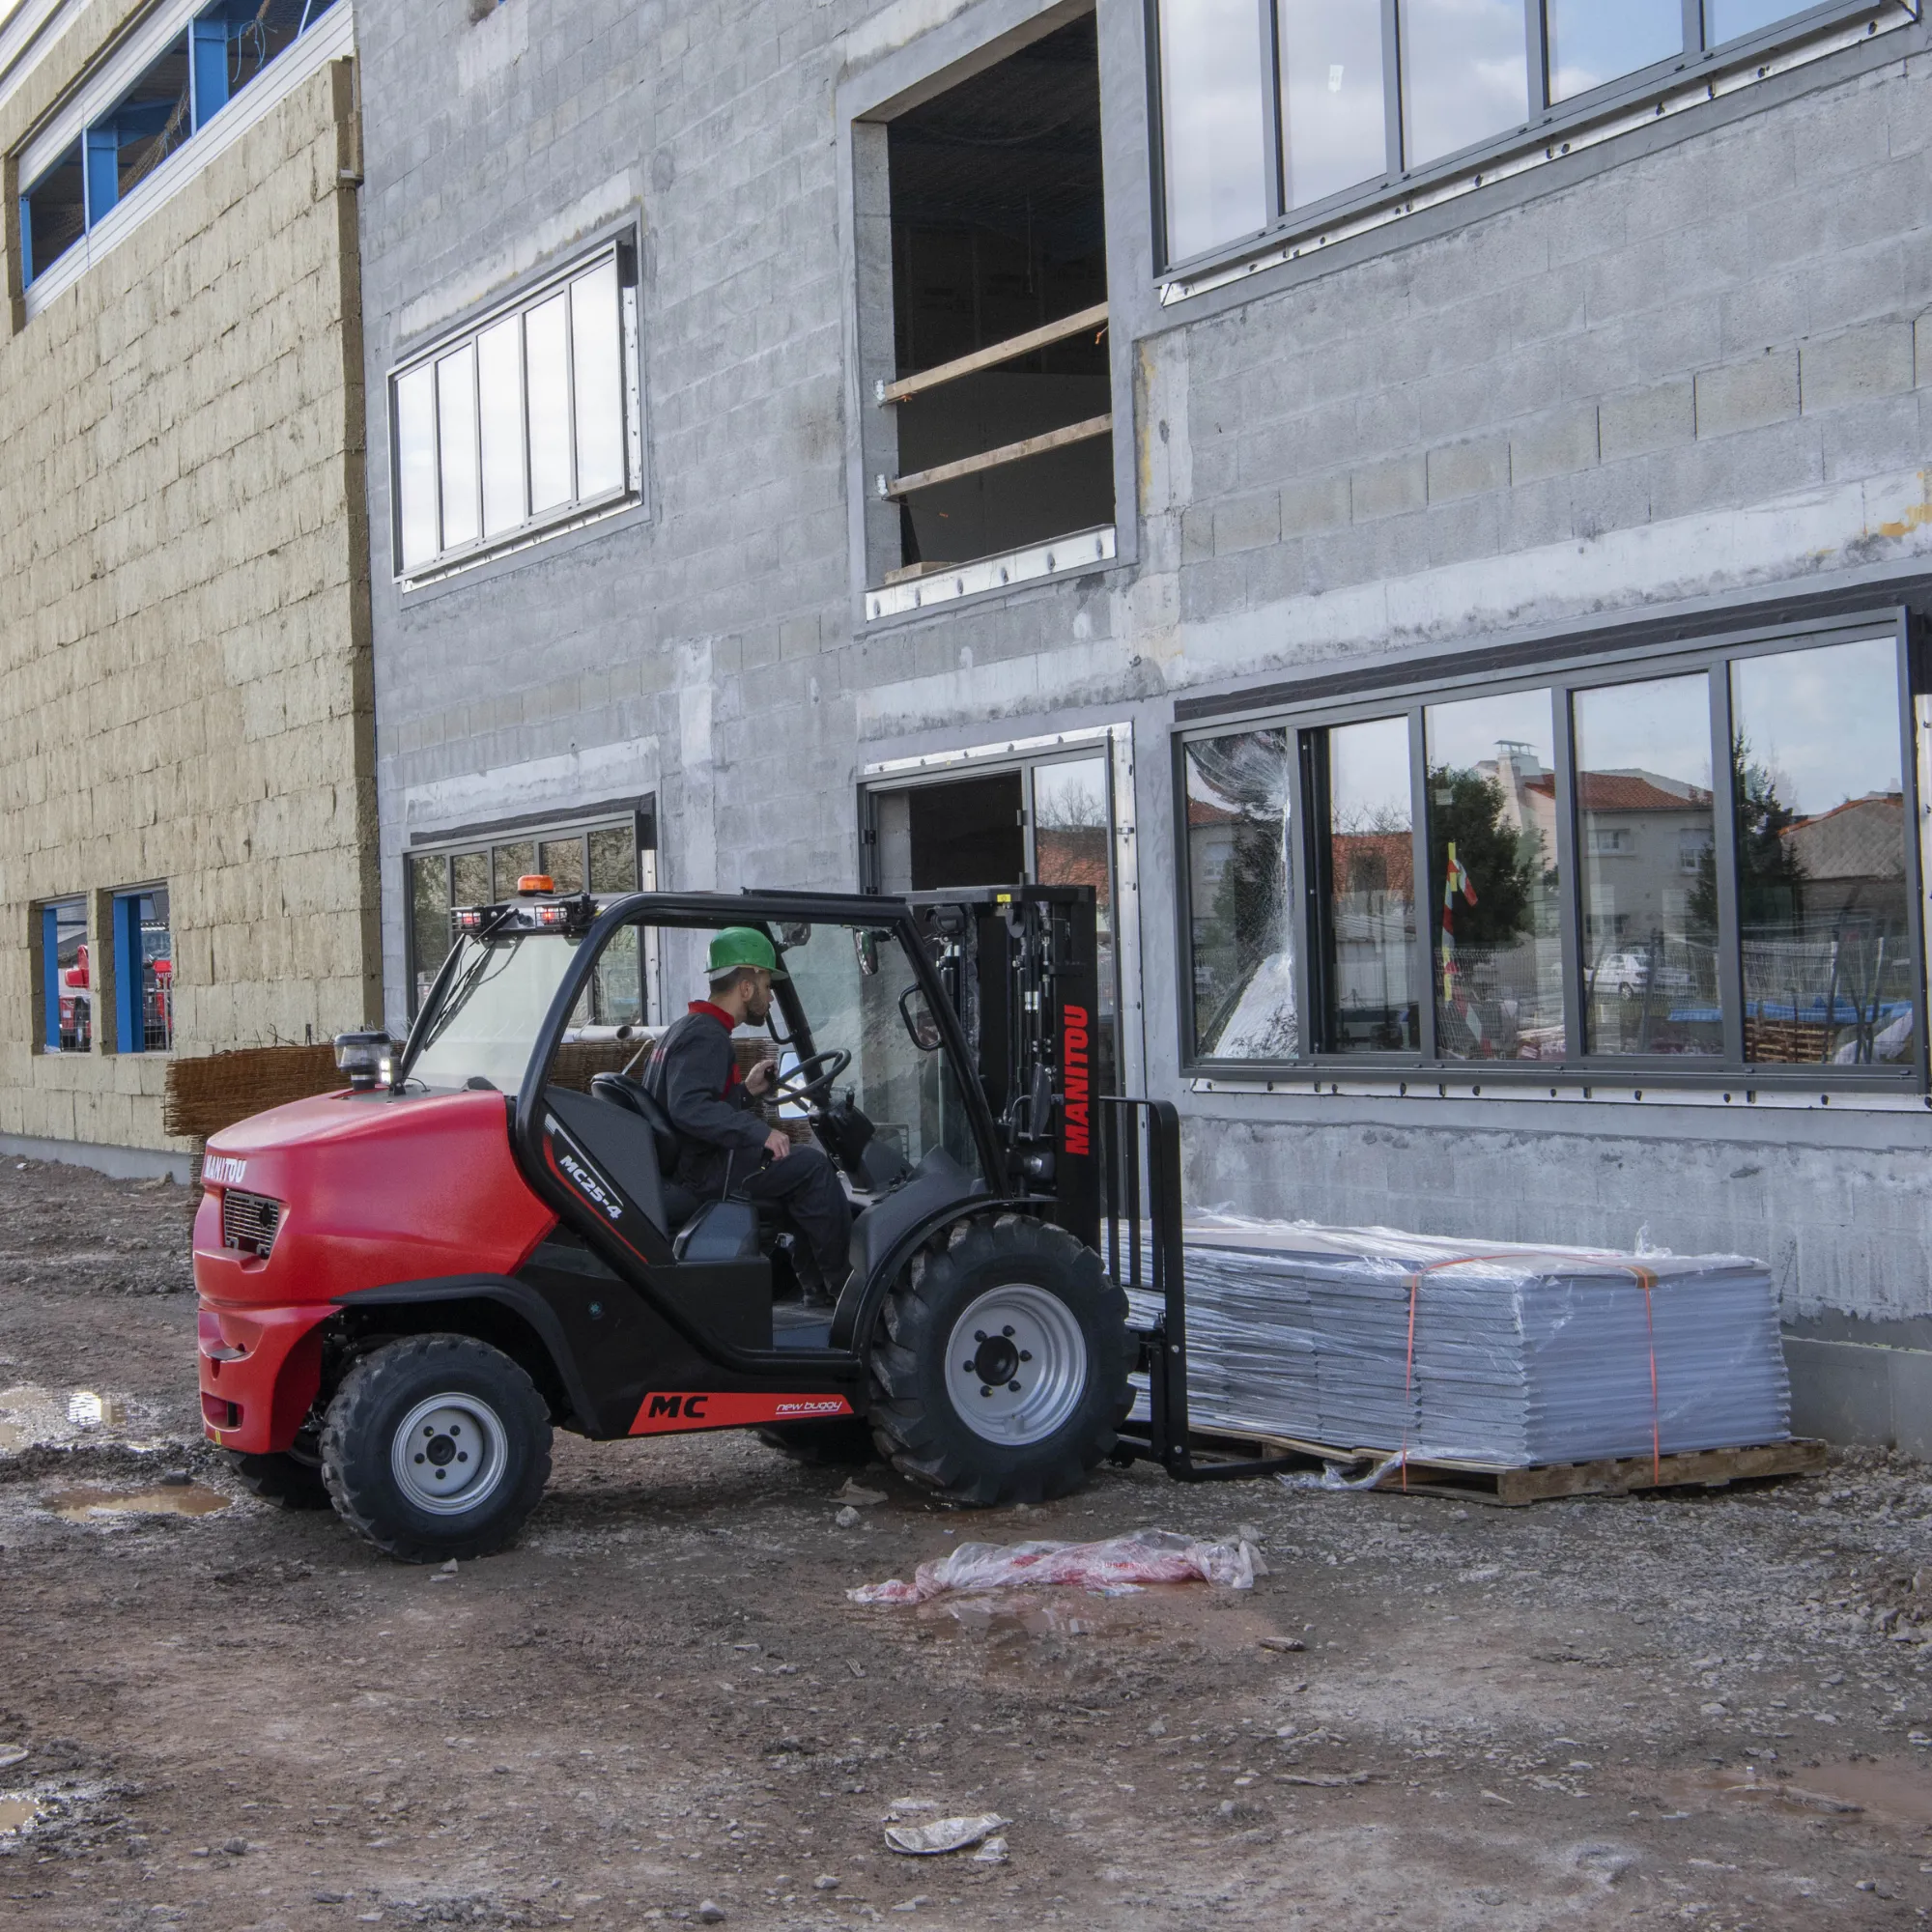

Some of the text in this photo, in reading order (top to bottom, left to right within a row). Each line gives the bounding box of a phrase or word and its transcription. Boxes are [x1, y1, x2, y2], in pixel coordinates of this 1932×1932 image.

[1064, 1005, 1090, 1155] MANITOU
[204, 1154, 247, 1183] MANITOU
[559, 1154, 623, 1219] MC25-4
[648, 1395, 709, 1418] MC
[776, 1401, 843, 1411] new buggy
